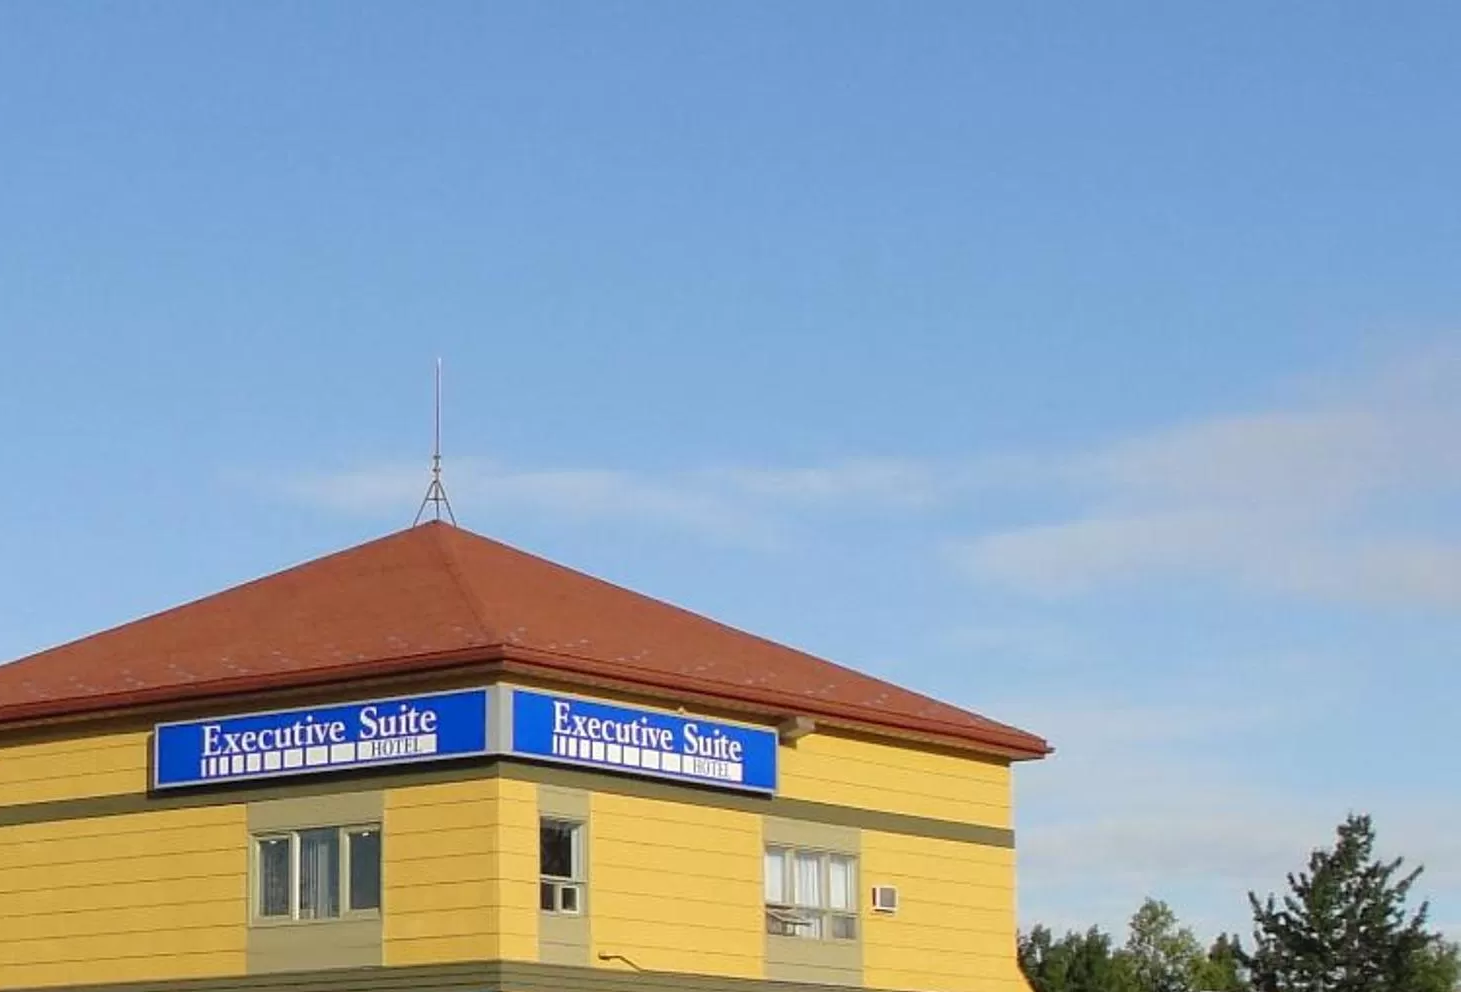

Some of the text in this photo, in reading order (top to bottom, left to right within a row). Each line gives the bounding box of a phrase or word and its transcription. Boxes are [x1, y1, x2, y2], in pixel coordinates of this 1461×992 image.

[202, 704, 437, 757] Executive Suite
[371, 735, 422, 757] HOTEL
[553, 701, 743, 761] Executive Suite
[692, 758, 730, 777] HOTEL
